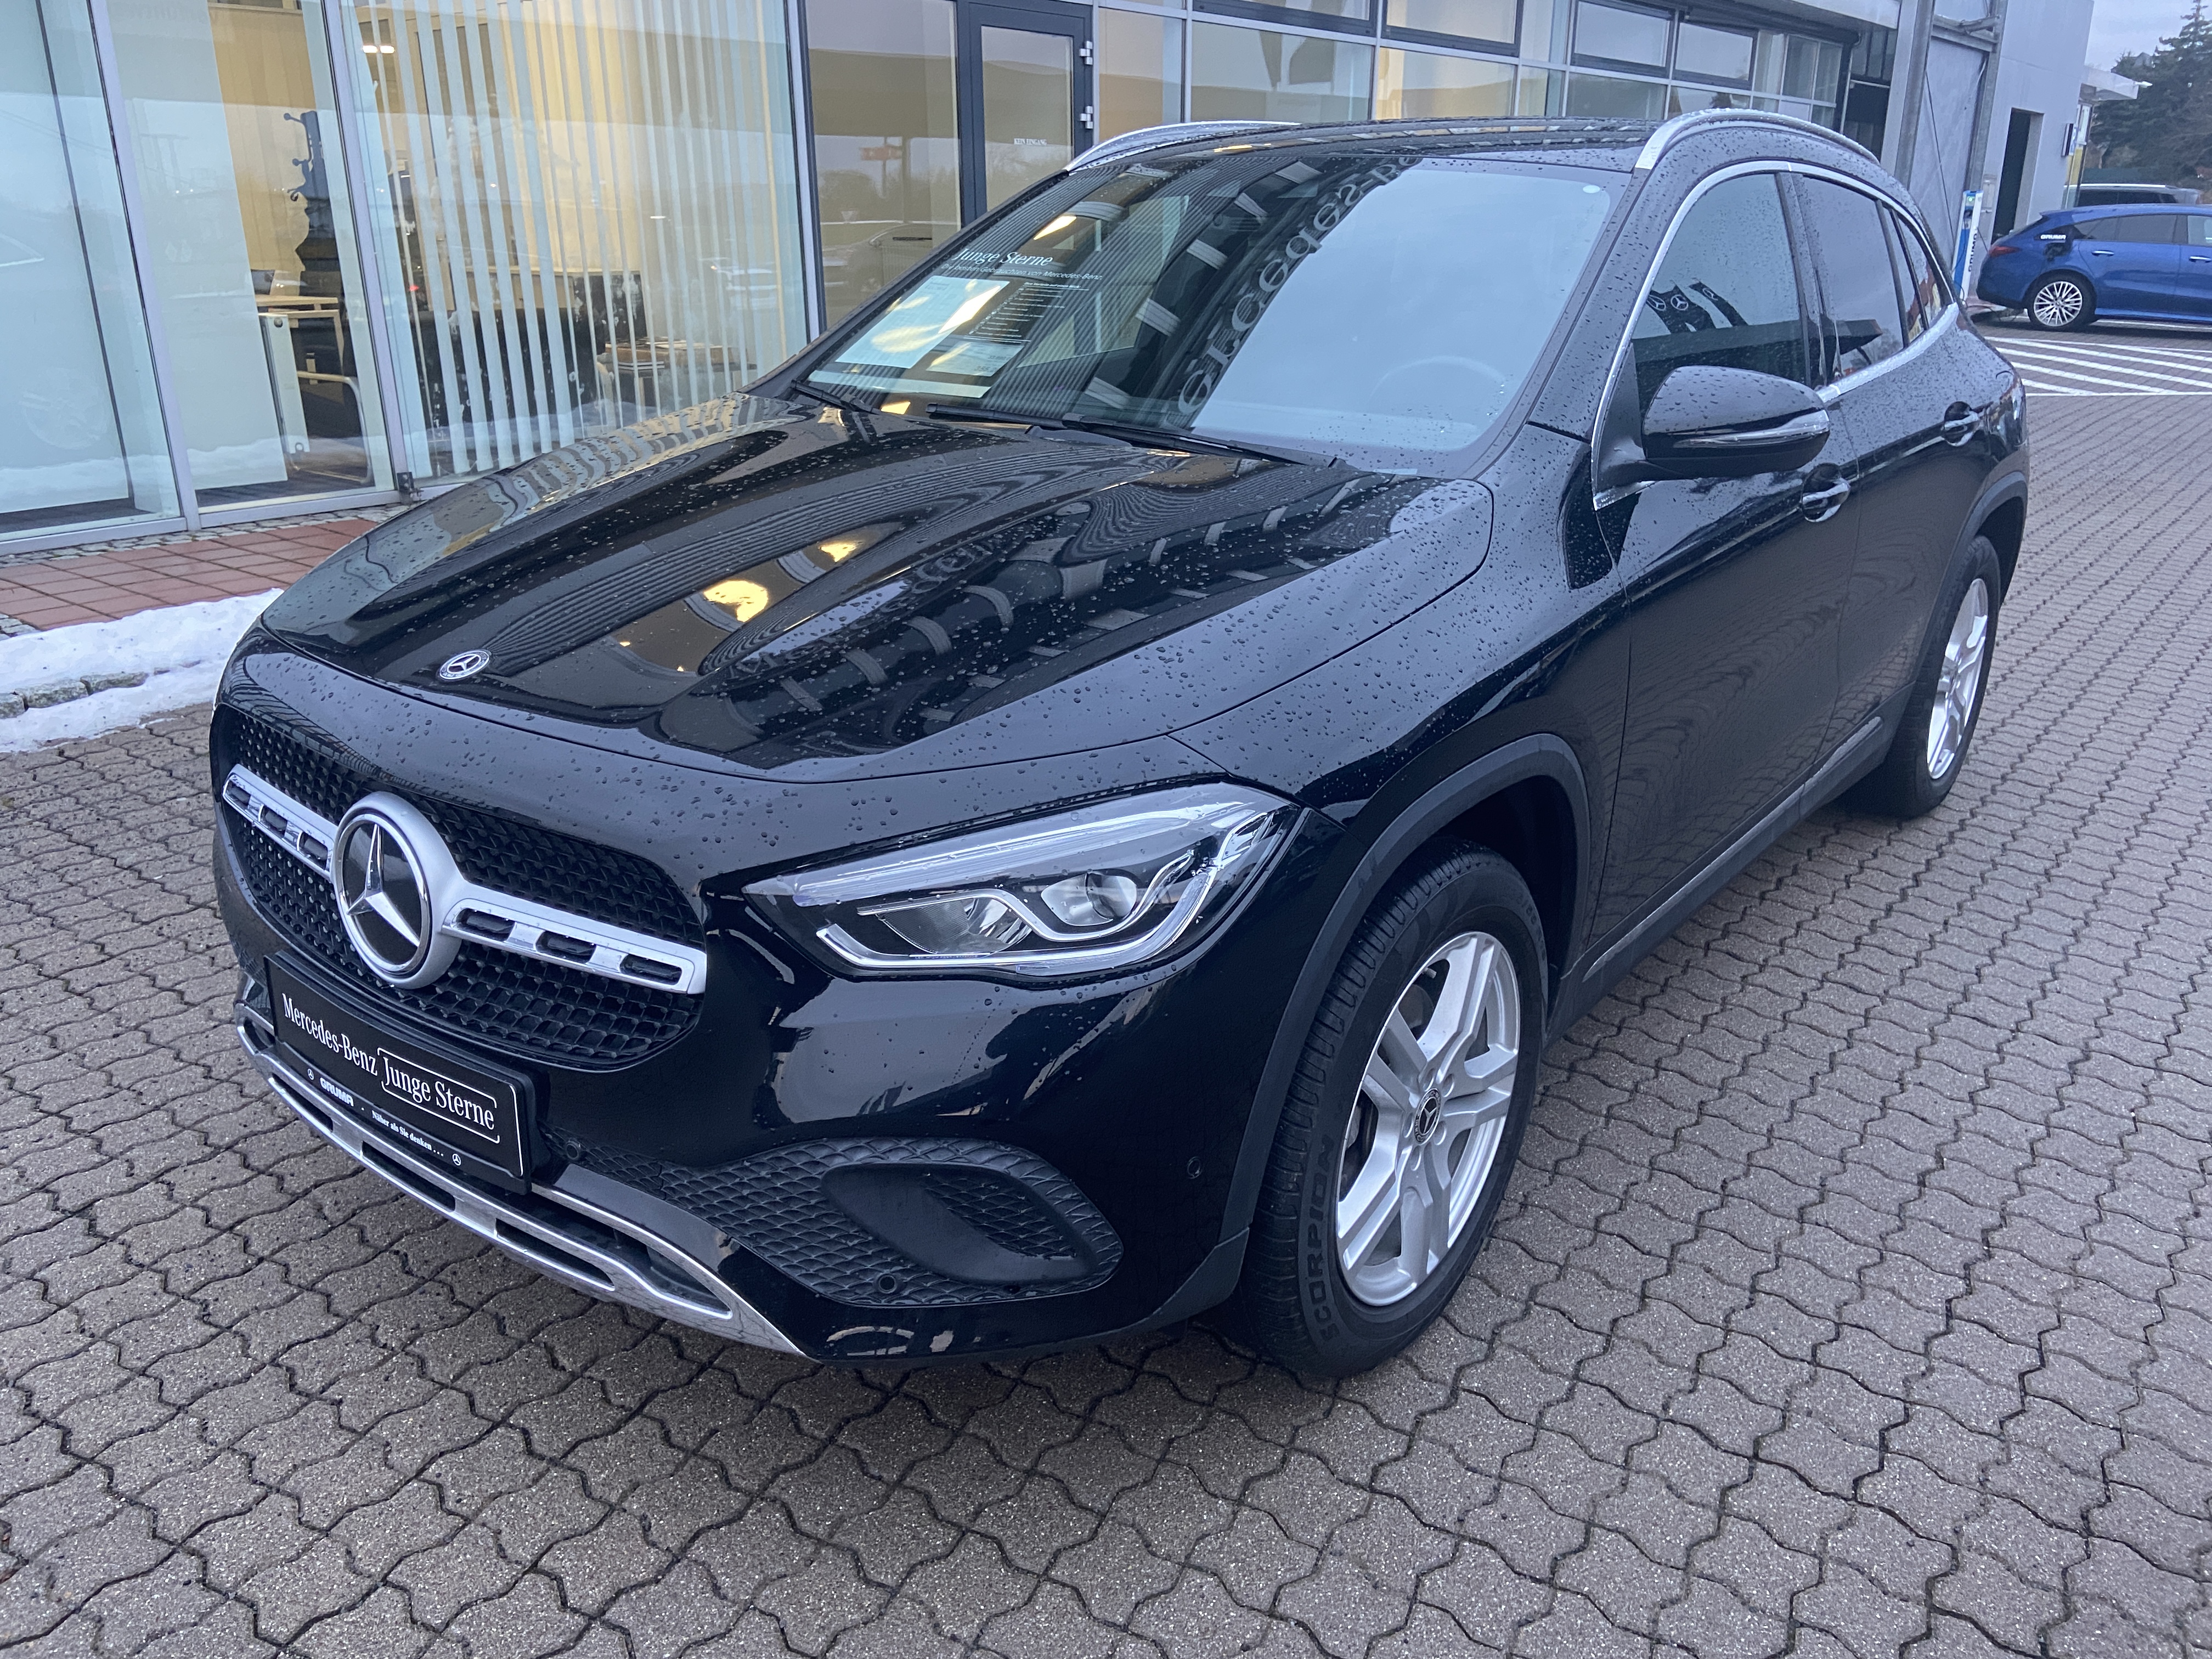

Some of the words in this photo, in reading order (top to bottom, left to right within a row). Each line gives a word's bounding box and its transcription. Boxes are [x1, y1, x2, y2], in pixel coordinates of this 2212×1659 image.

[952, 249, 1000, 264] Junge
[1000, 251, 1054, 266] Sterne
[281, 993, 378, 1076] Mercedes-Benz
[383, 1057, 431, 1103] Junge
[435, 1081, 495, 1130] Sterne
[320, 1077, 354, 1107] GRUMA
[371, 1110, 390, 1127] Näher
[390, 1122, 399, 1133] als
[399, 1126, 409, 1138] Sie
[409, 1133, 432, 1150] denken
[1308, 1136, 1340, 1342] SCORPION
